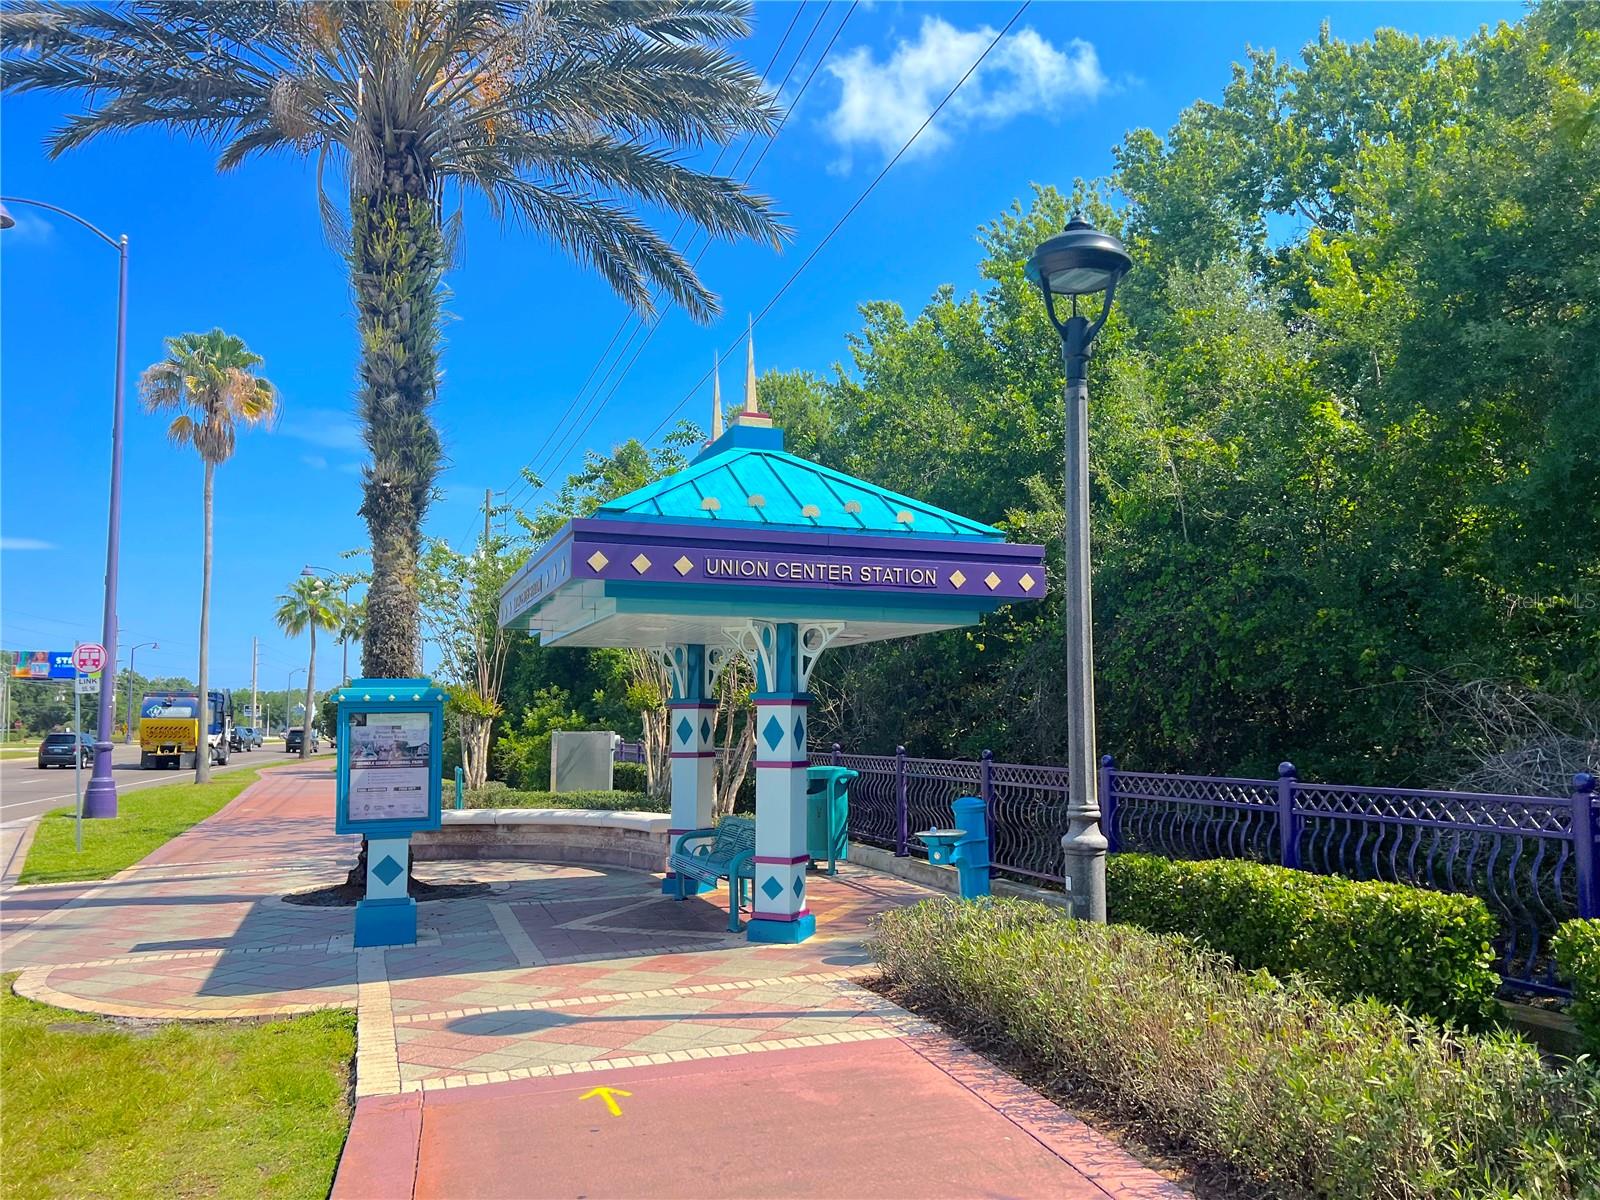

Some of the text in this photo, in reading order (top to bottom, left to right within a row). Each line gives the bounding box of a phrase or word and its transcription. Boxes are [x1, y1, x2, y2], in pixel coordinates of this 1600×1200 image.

[706, 558, 937, 585] UNION CENTER STATION
